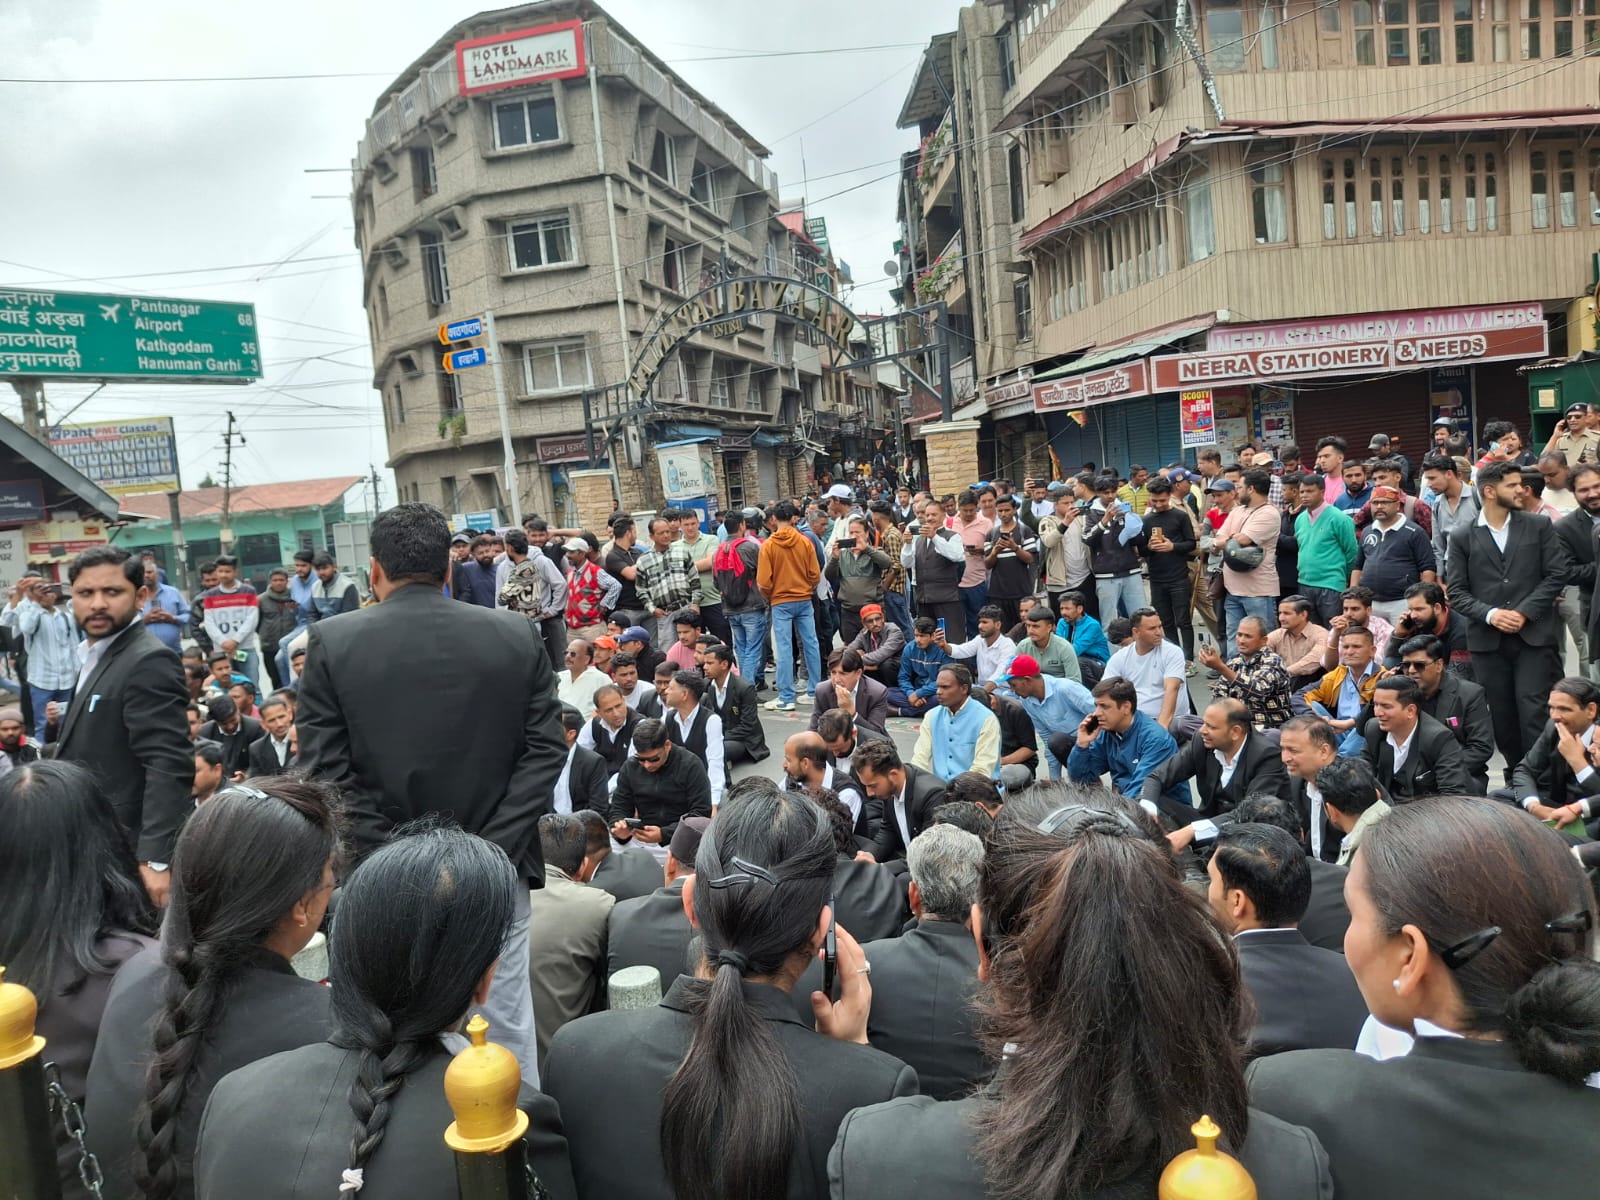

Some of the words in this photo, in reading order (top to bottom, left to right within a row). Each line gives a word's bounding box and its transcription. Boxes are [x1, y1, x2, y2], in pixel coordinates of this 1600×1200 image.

[472, 44, 518, 61] HOTEL
[474, 49, 569, 78] LANDMARK
[131, 299, 201, 317] Pantnagar
[733, 280, 853, 347] BAZAAR
[135, 317, 184, 334] Airport
[237, 313, 253, 326] 68
[1216, 331, 1278, 351] NEERA
[1285, 319, 1399, 345] STATIONERY
[1481, 307, 1538, 328] NEEDS
[135, 338, 214, 355] Kathgodam
[241, 342, 257, 355] 35
[138, 356, 202, 370] Hanuman
[206, 358, 241, 372] Garhi
[250, 360, 259, 372] 3
[1183, 358, 1251, 378] NEERA
[1261, 346, 1385, 371] STATIONERY
[1401, 344, 1413, 358] &
[1421, 337, 1484, 357] NEEDS
[1183, 391, 1210, 401] SCOOTY
[1190, 402, 1211, 412] RENT
[63, 428, 93, 438] Pant
[119, 424, 158, 434] Classes
